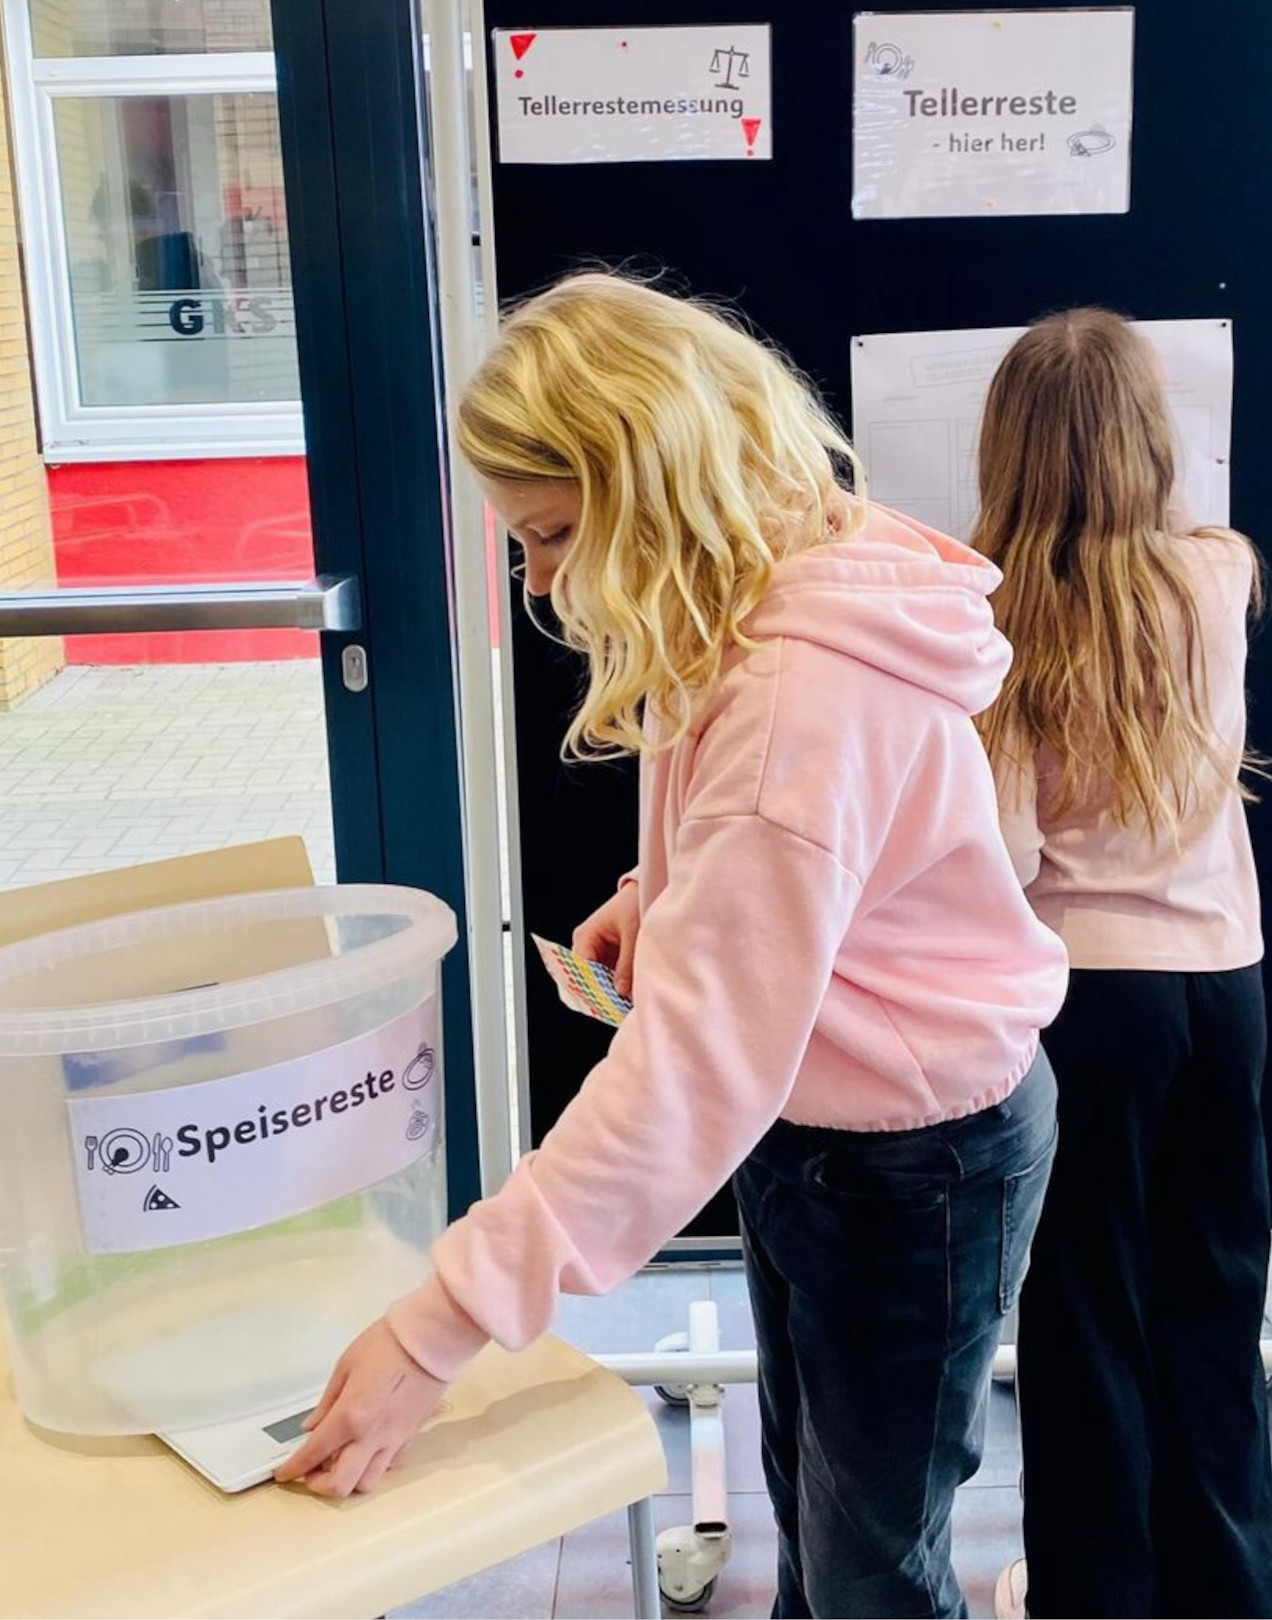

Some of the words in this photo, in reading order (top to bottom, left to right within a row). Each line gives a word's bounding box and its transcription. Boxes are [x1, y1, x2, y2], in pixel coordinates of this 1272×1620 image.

[518, 95, 744, 119] Tellerrestemessung
[903, 87, 1077, 117] Tellerreste
[949, 132, 993, 153] hier
[1001, 132, 1046, 152] her!
[169, 297, 277, 336] GKS
[176, 1068, 396, 1164] Speisereste
